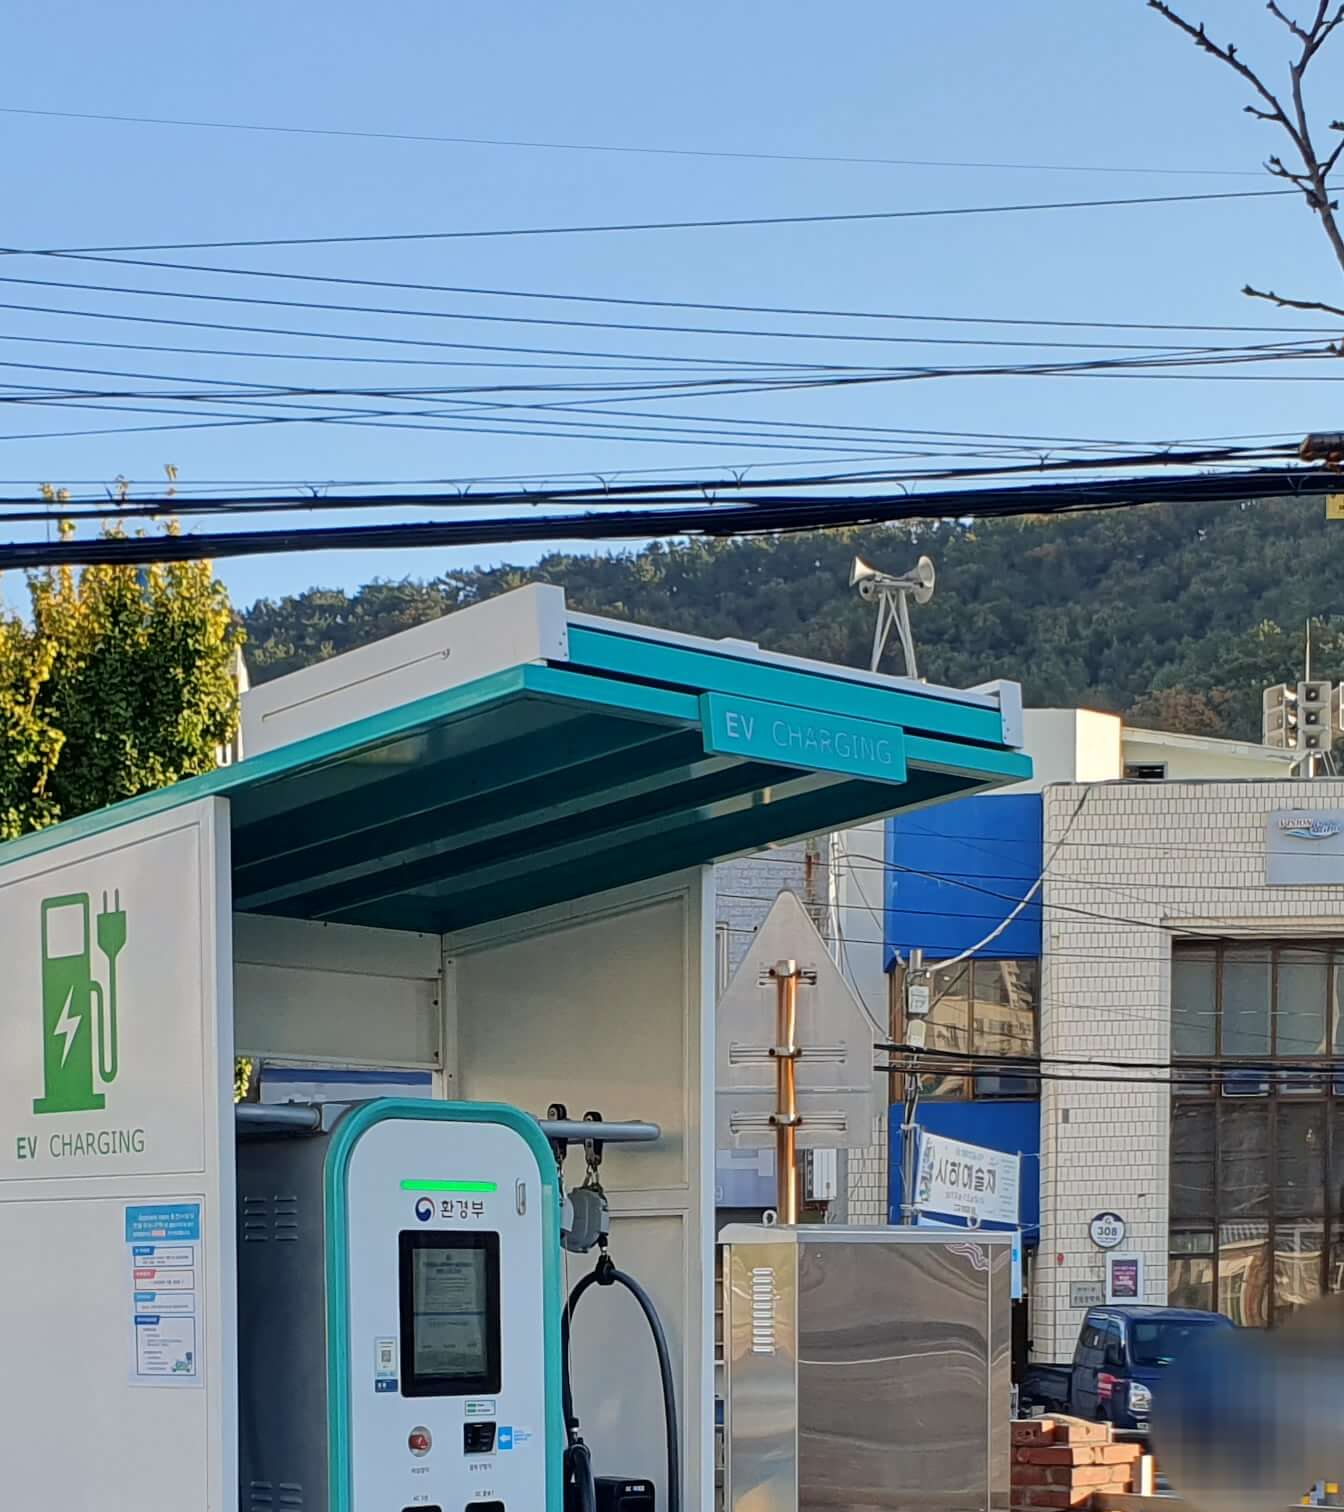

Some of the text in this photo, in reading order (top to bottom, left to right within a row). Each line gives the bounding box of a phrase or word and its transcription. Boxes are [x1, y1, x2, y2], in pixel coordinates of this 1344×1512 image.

[725, 711, 892, 764] EV CHARGING
[16, 1128, 145, 1159] EV CHARGING
[440, 1199, 485, 1219] 환경부
[1097, 1226, 1118, 1237] 308
